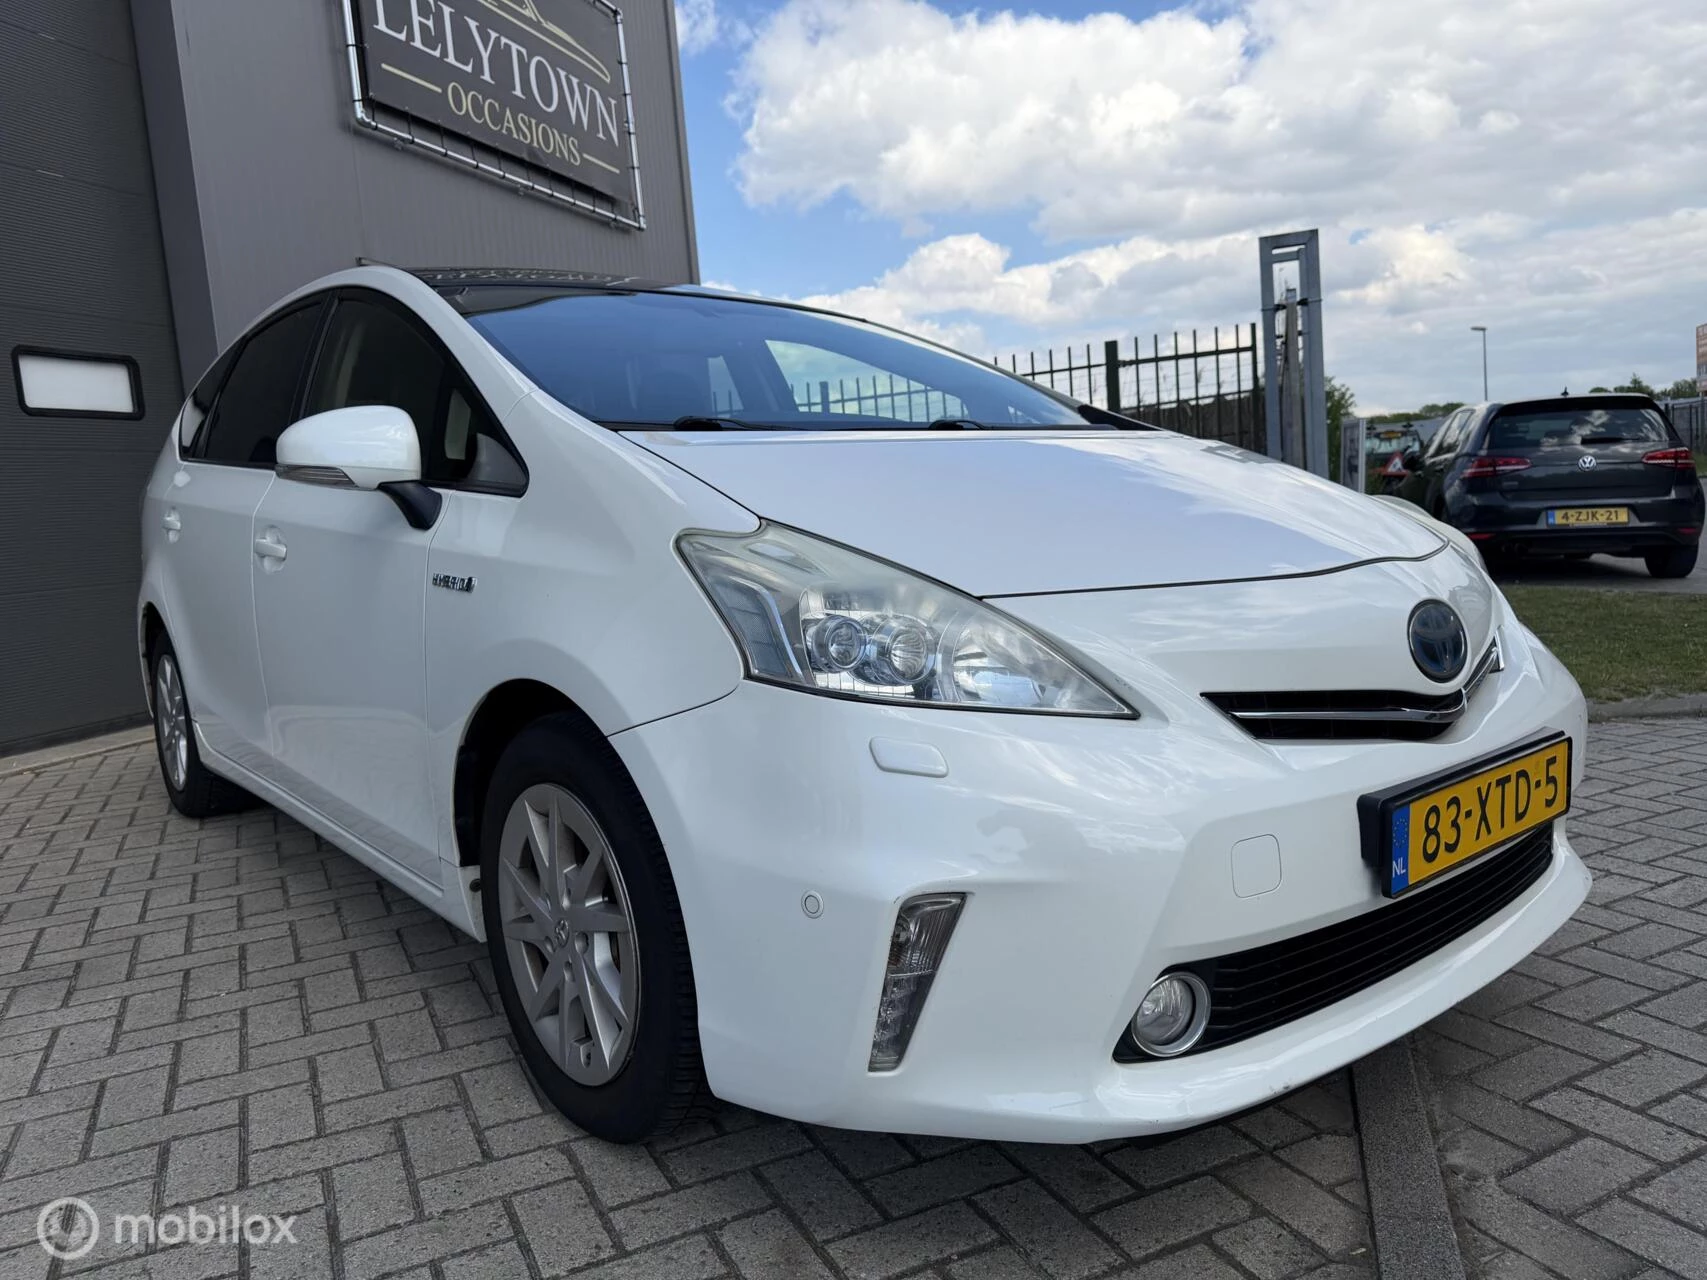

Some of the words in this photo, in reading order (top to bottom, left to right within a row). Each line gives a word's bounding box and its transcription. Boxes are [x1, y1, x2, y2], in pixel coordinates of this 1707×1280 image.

[373, 0, 619, 147] LELYTOWN
[447, 82, 581, 166] OCCASIONS
[1561, 510, 1619, 522] 4-ZJK-21
[1422, 756, 1558, 863] 83-XTD-5
[1392, 857, 1406, 878] NL
